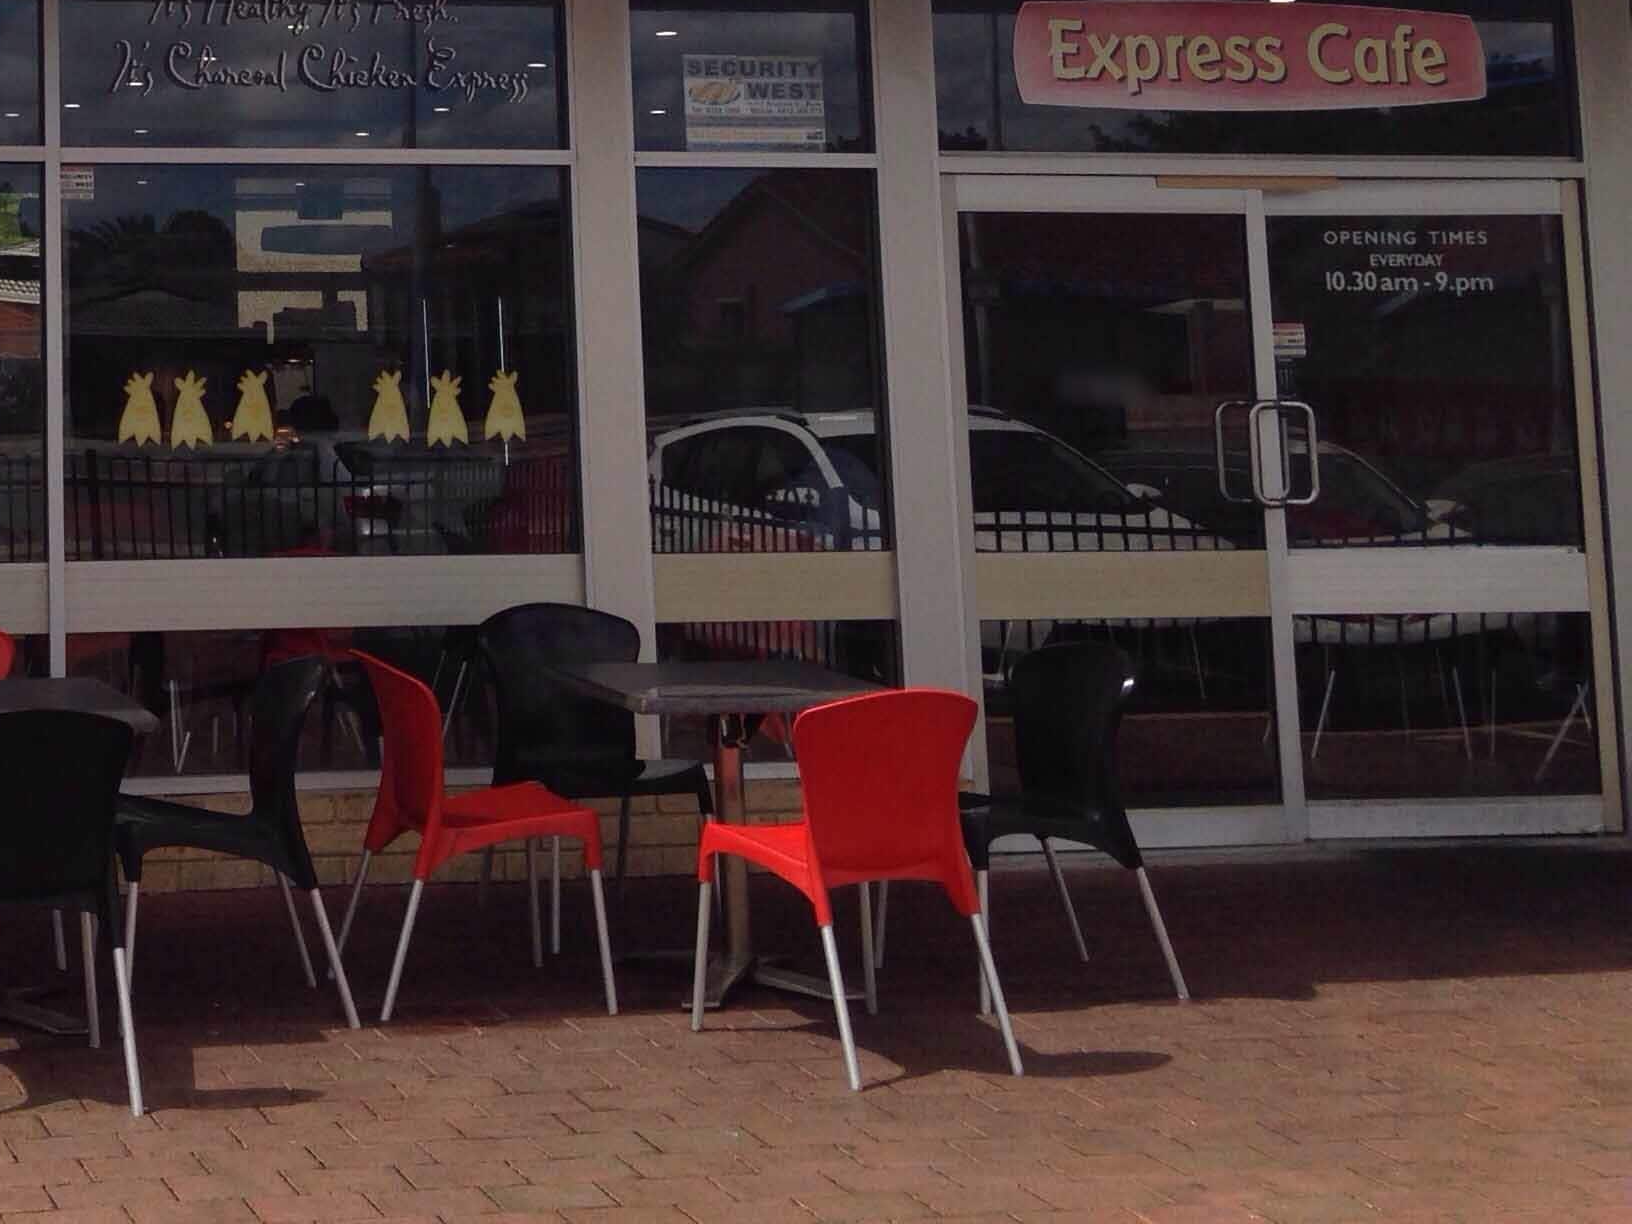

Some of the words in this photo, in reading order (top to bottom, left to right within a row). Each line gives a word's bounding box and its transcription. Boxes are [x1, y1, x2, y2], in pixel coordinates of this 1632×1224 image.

[1047, 17, 1289, 97] Express
[1306, 22, 1450, 87] Cafe
[298, 43, 418, 92] Chicken
[686, 60, 818, 77] SECURITY
[747, 82, 821, 100] WEST
[1323, 230, 1417, 246] OPENING
[1428, 230, 1489, 246] TIMES
[1369, 252, 1445, 268] EVERYDAY
